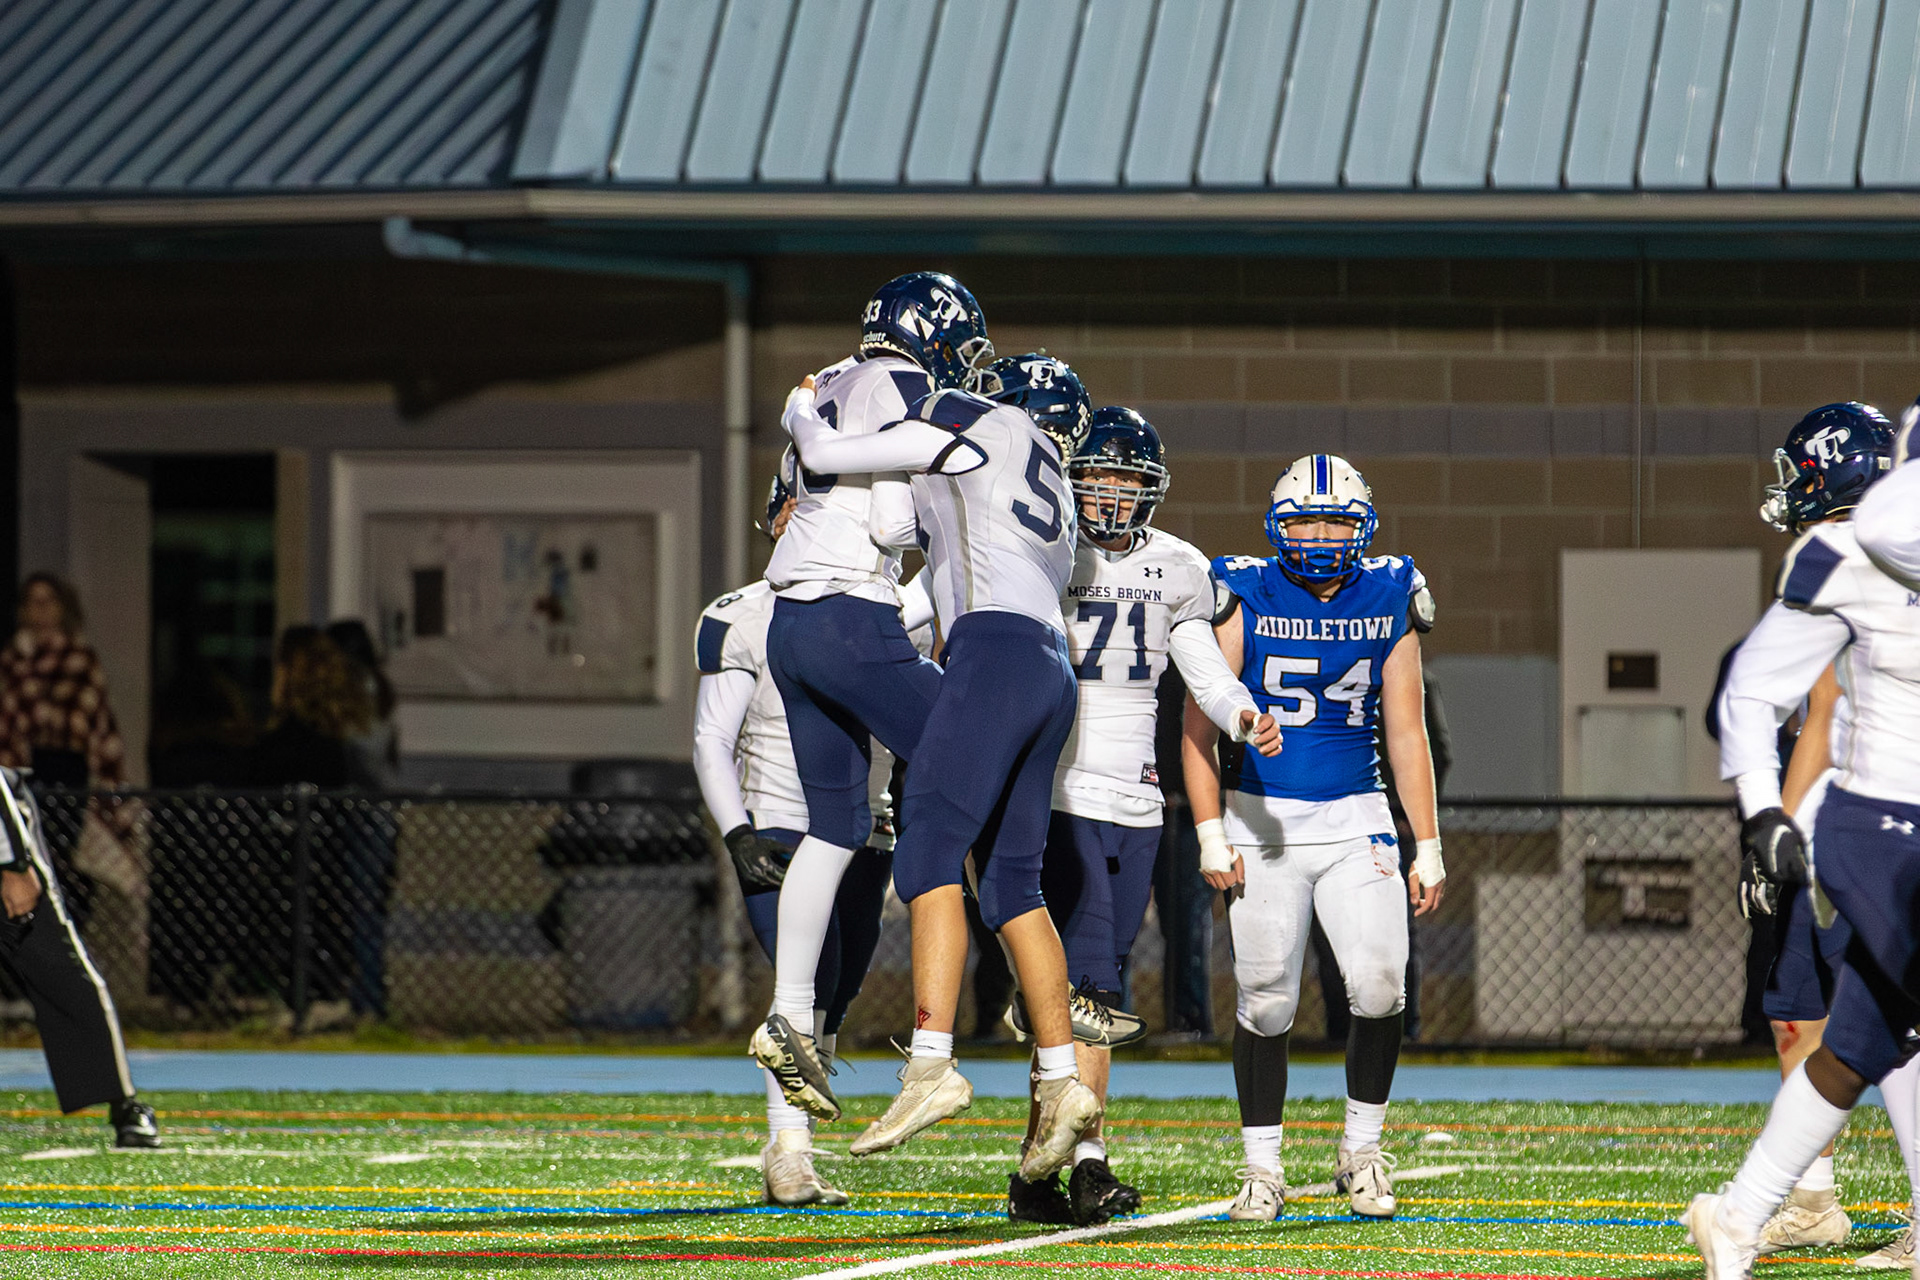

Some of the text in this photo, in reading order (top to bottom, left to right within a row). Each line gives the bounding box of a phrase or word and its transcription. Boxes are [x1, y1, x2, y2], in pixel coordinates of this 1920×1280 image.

[1068, 586, 1162, 601] MOSES BROWN
[1075, 600, 1152, 681] 71
[1254, 615, 1394, 641] MIDDLETOWN
[1263, 654, 1373, 727] 54
